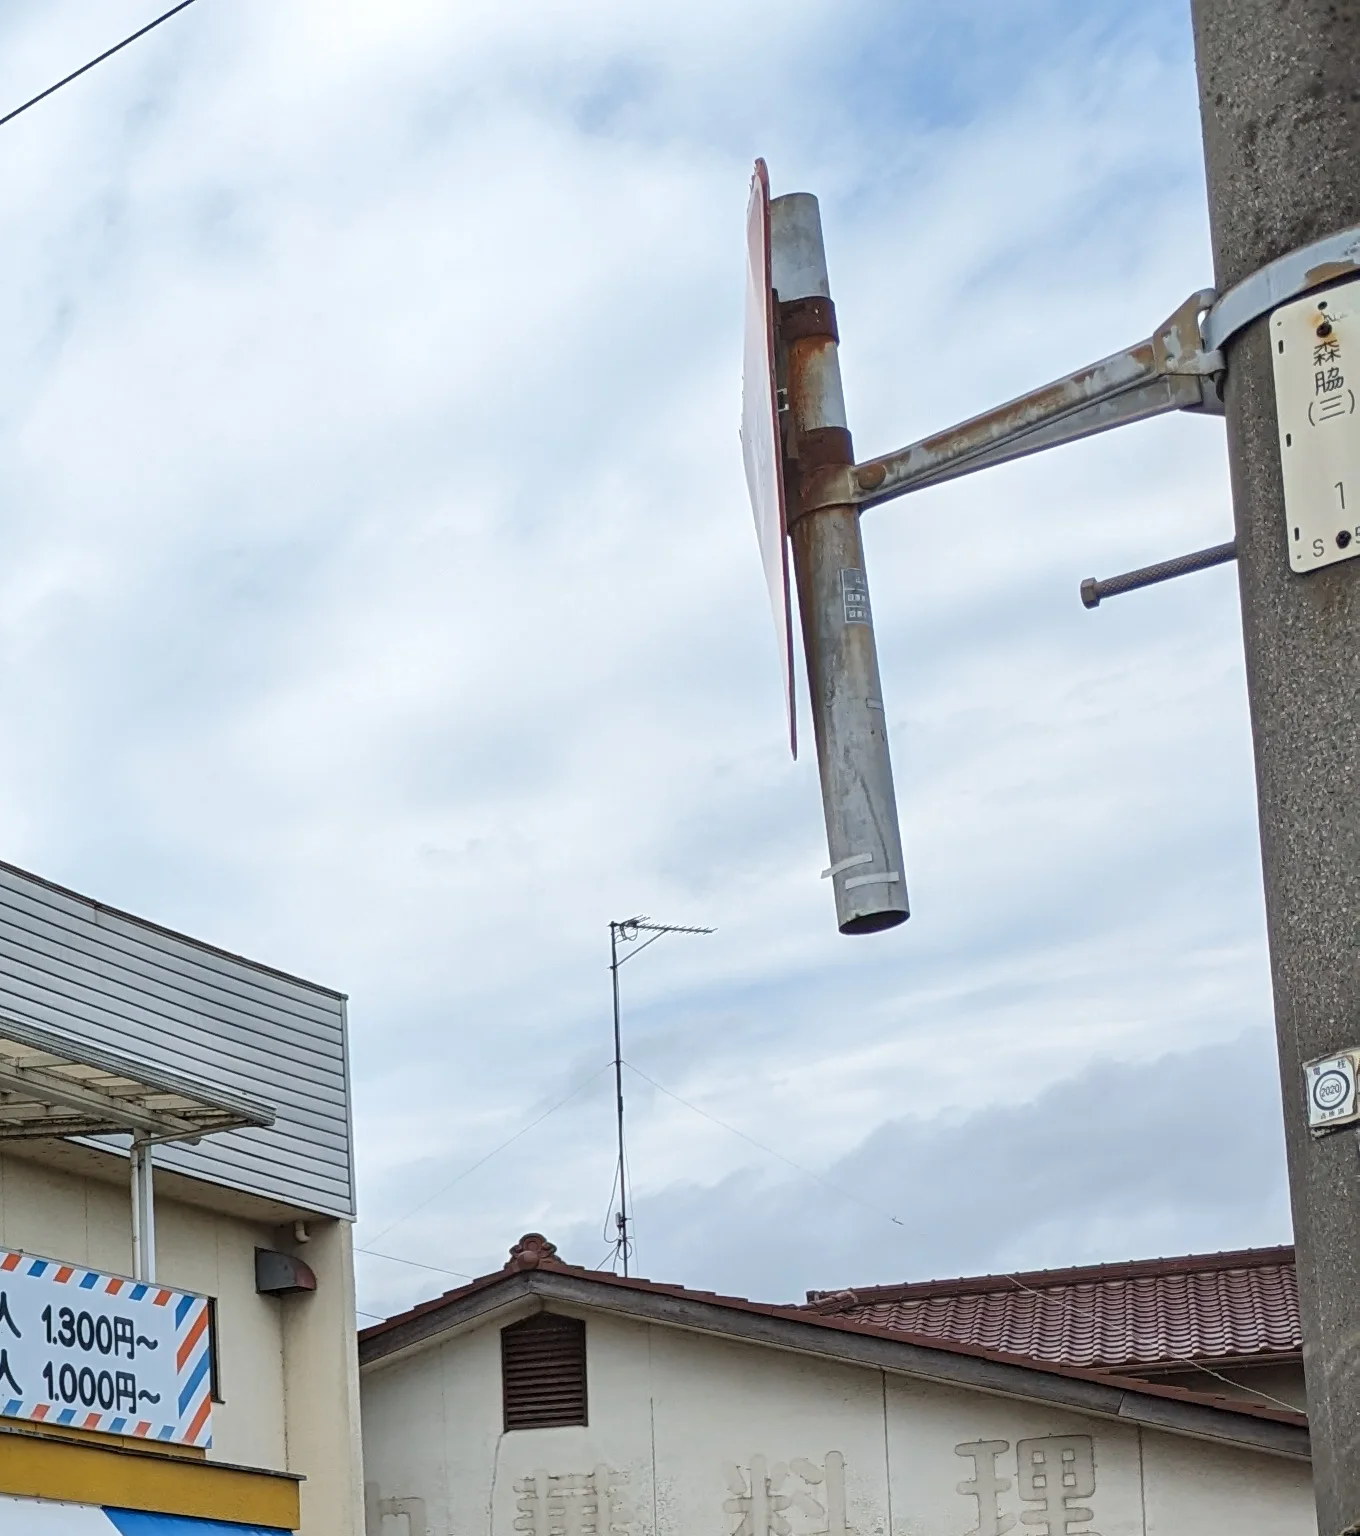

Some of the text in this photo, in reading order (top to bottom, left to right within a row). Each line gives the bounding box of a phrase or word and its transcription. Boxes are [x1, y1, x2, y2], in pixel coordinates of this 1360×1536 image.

[1308, 339, 1356, 427] 森脇(三)
[1312, 537, 1325, 558] S
[1321, 1083, 1340, 1097] 2020
